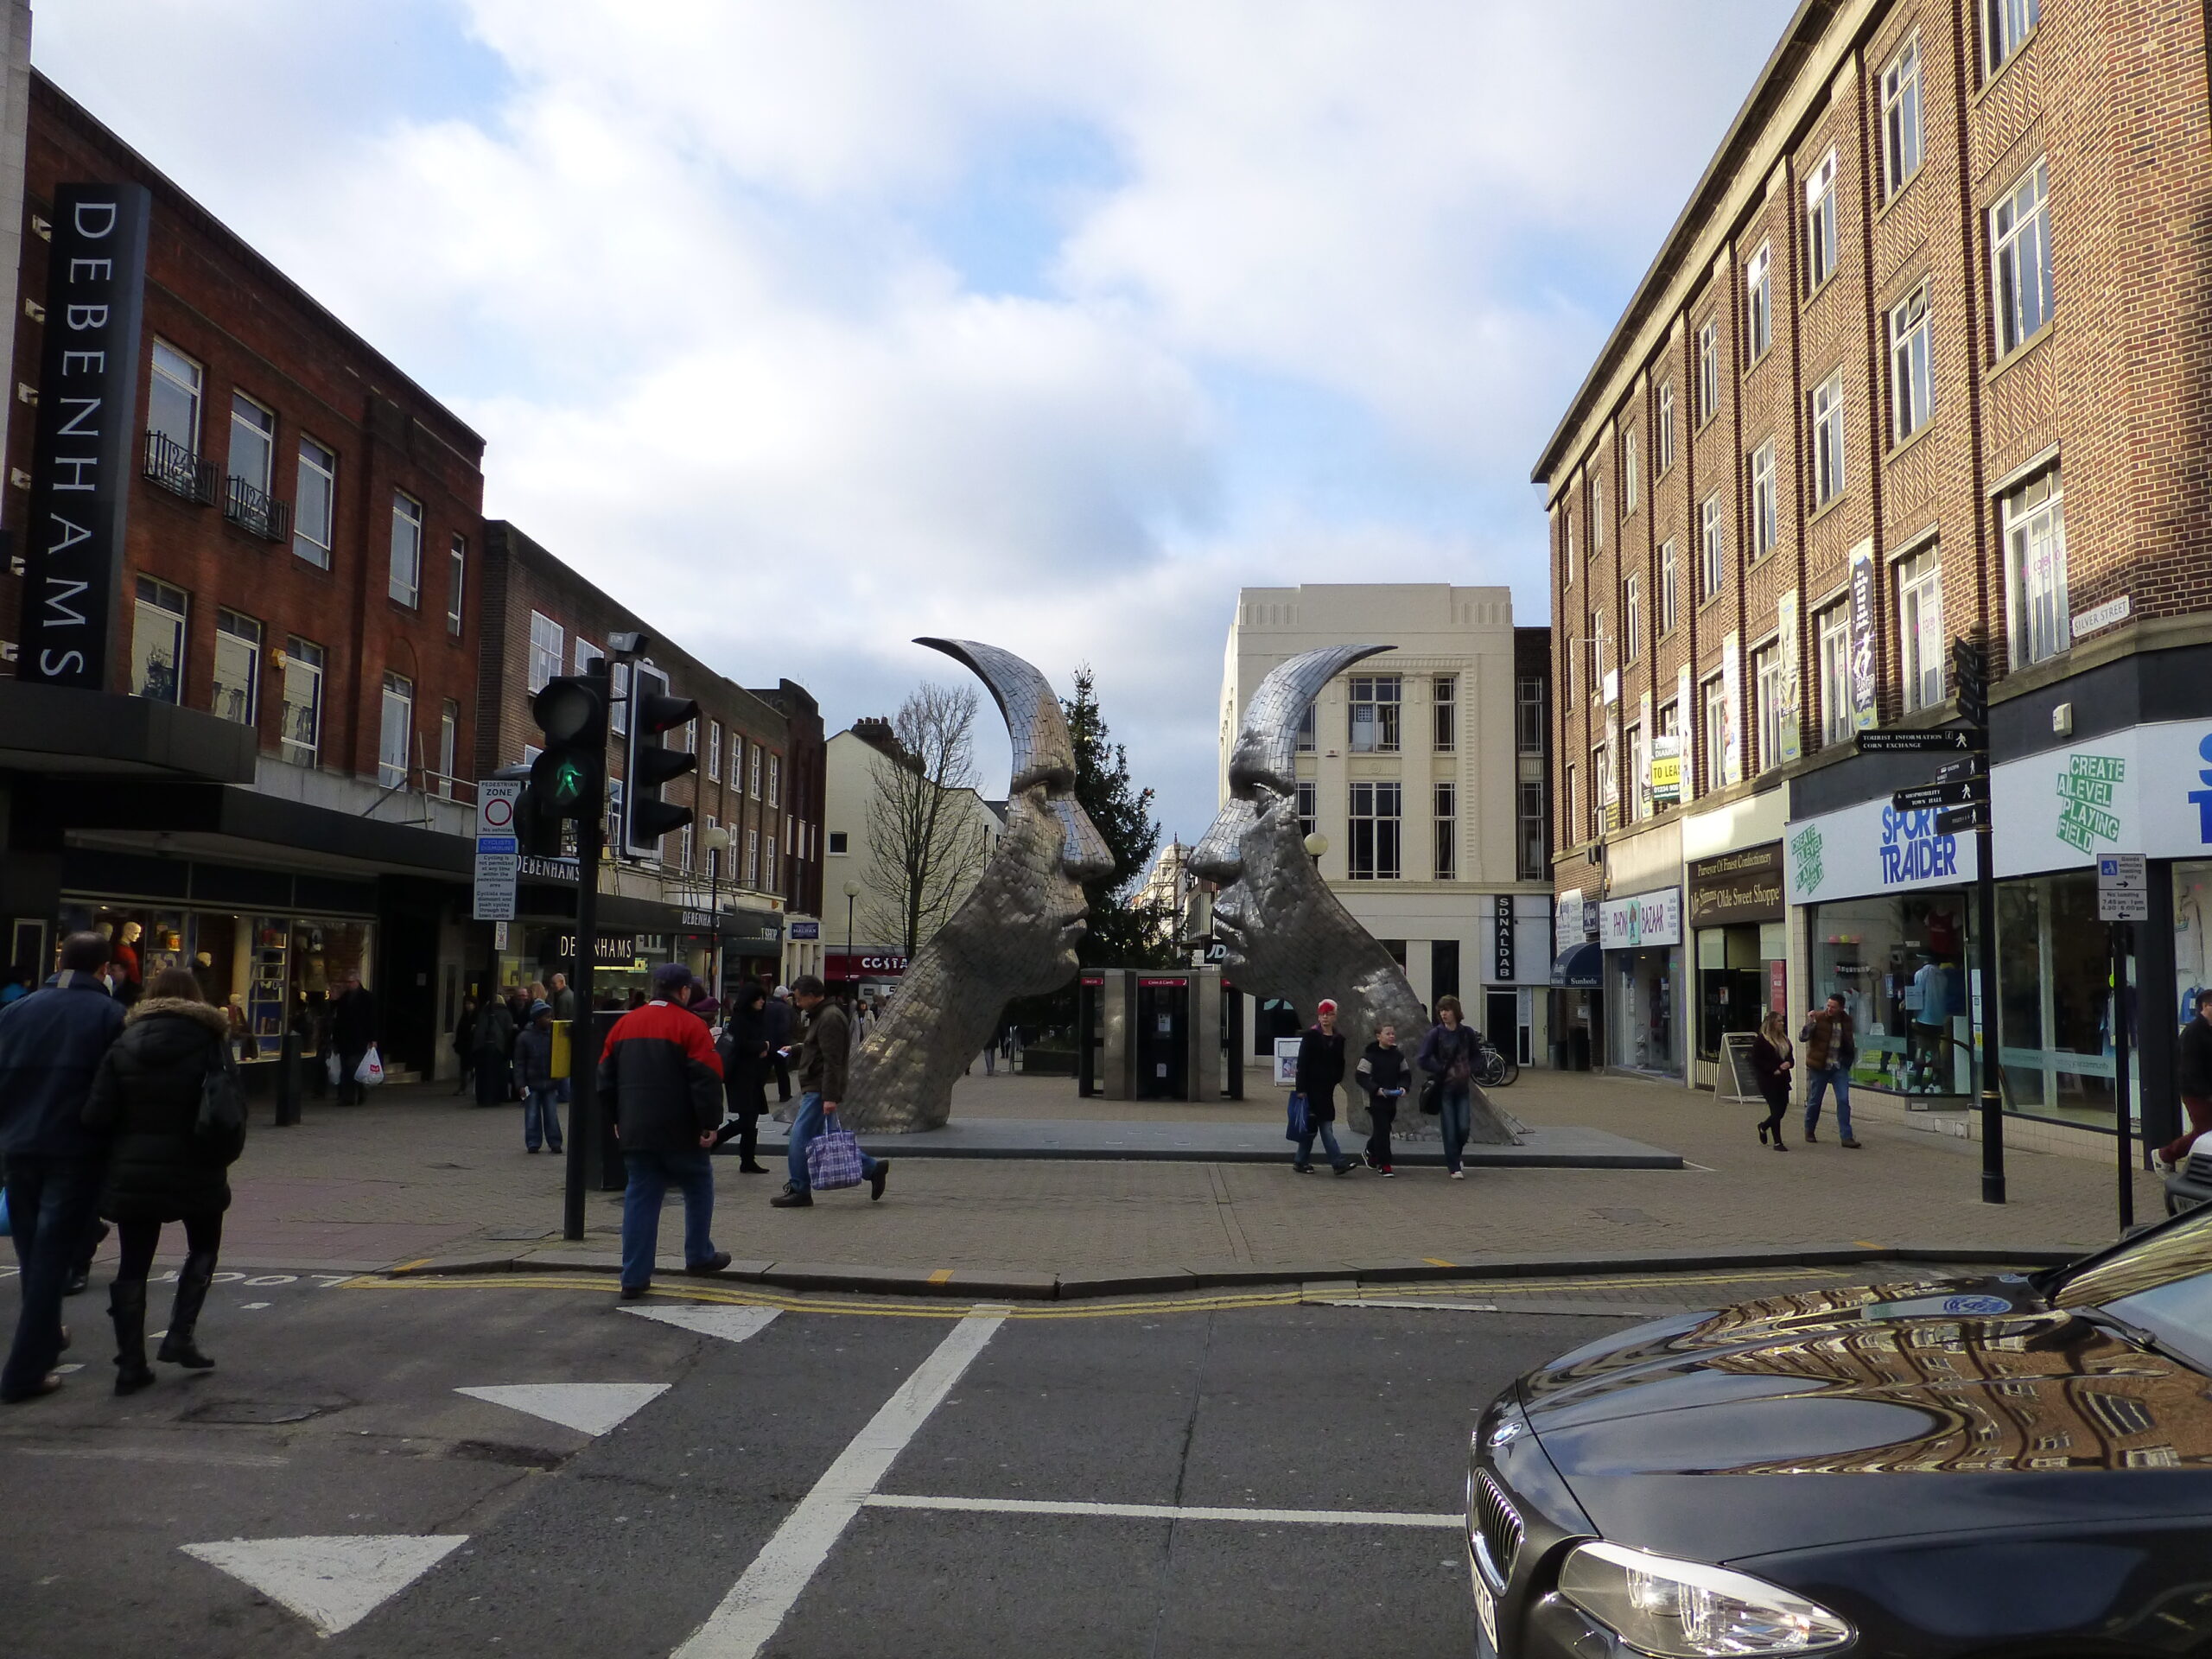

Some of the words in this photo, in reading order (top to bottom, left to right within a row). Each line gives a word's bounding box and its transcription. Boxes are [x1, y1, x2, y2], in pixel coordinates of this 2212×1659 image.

[40, 202, 117, 677] DEBENHAMS
[2075, 613, 2099, 632] SILVER
[2101, 601, 2126, 621] STREET
[1653, 767, 1662, 779] TO
[2070, 756, 2125, 780] CREATE
[1905, 790, 1941, 799] SHOPMOBILITY
[2069, 779, 2112, 805] LEVEL
[2063, 798, 2119, 839] PLAYING
[1791, 825, 1816, 853] CREATE
[2057, 820, 2094, 852] FIELD
[1801, 836, 1822, 863] LEVEL
[1879, 834, 1957, 884] TRAIDER
[1697, 864, 1717, 877] Purveyor
[1717, 859, 1724, 873] Of
[1724, 857, 1738, 871] Finest
[1738, 852, 1772, 868] Confectionery
[1795, 853, 1821, 890] PLAYING
[1807, 866, 1824, 894] FIELD
[1717, 889, 1732, 908] Olde
[1732, 888, 1752, 906] Sweet
[1753, 884, 1780, 906] Shoppe
[683, 911, 721, 928] DEBENHAS
[1642, 904, 1664, 935] BAZAAR
[561, 936, 632, 958] DENHAMS
[765, 928, 778, 941] SHOP
[862, 957, 908, 969] COSTA
[1206, 944, 1227, 959] JD
